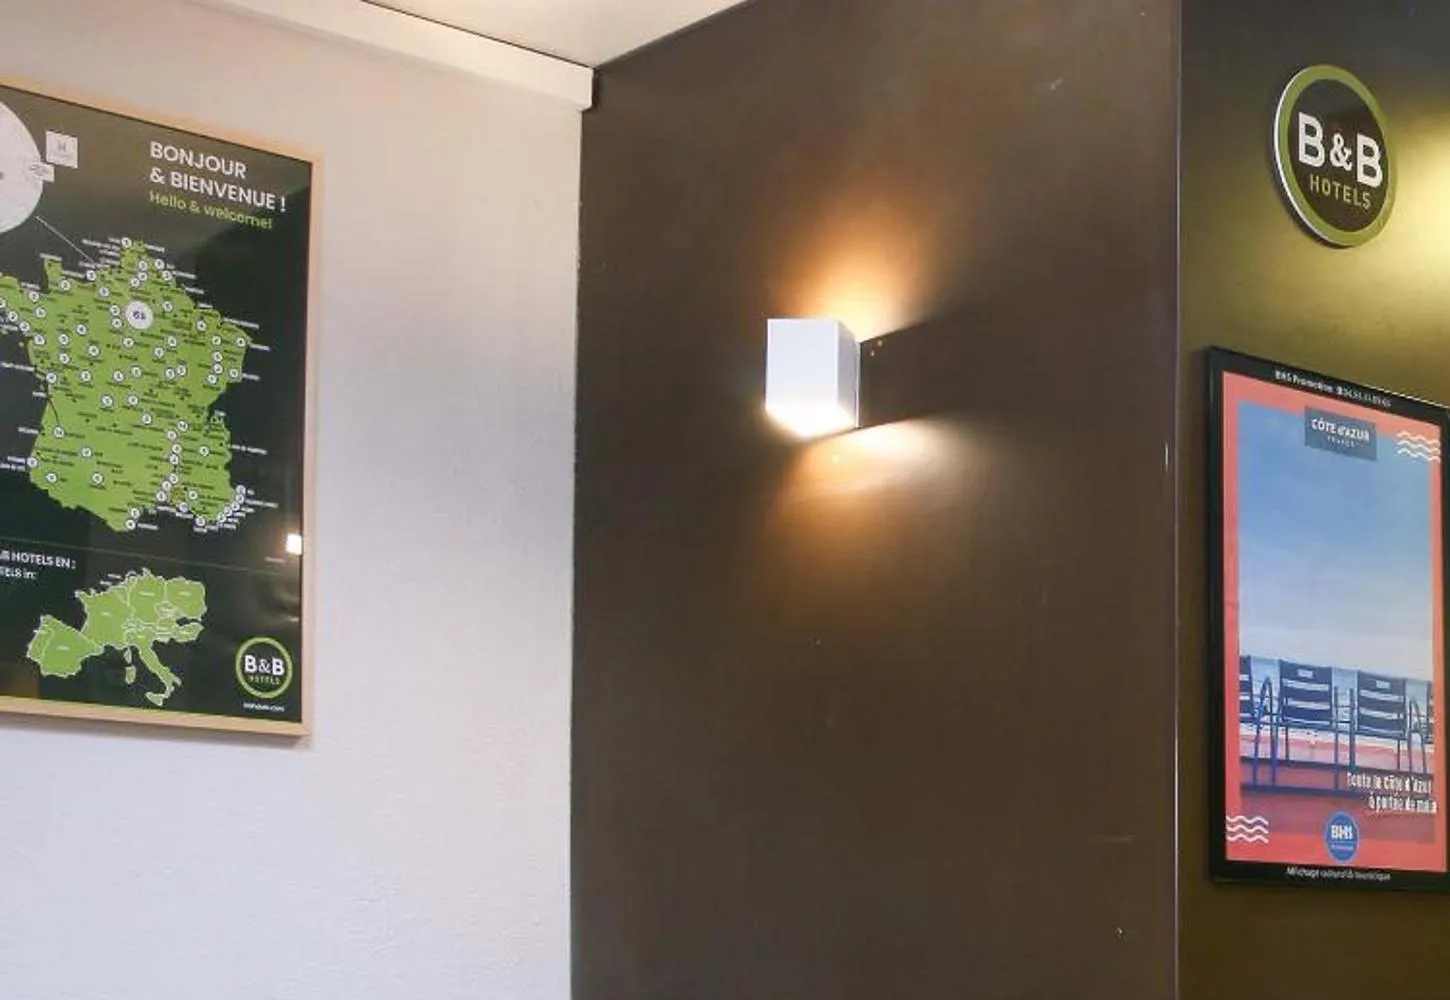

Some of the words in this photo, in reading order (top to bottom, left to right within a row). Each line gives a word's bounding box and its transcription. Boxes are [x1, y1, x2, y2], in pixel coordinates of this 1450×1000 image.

[150, 141, 247, 179] BONJOUR
[1298, 111, 1383, 188] B&B
[149, 167, 165, 185] &
[170, 171, 276, 211] BIENVENUE
[1309, 173, 1373, 211] HOTELS
[150, 190, 187, 210] Hello
[188, 200, 201, 214] &
[203, 205, 273, 229] welcome!
[11, 551, 54, 566] HOTELS
[244, 654, 285, 675] B&B
